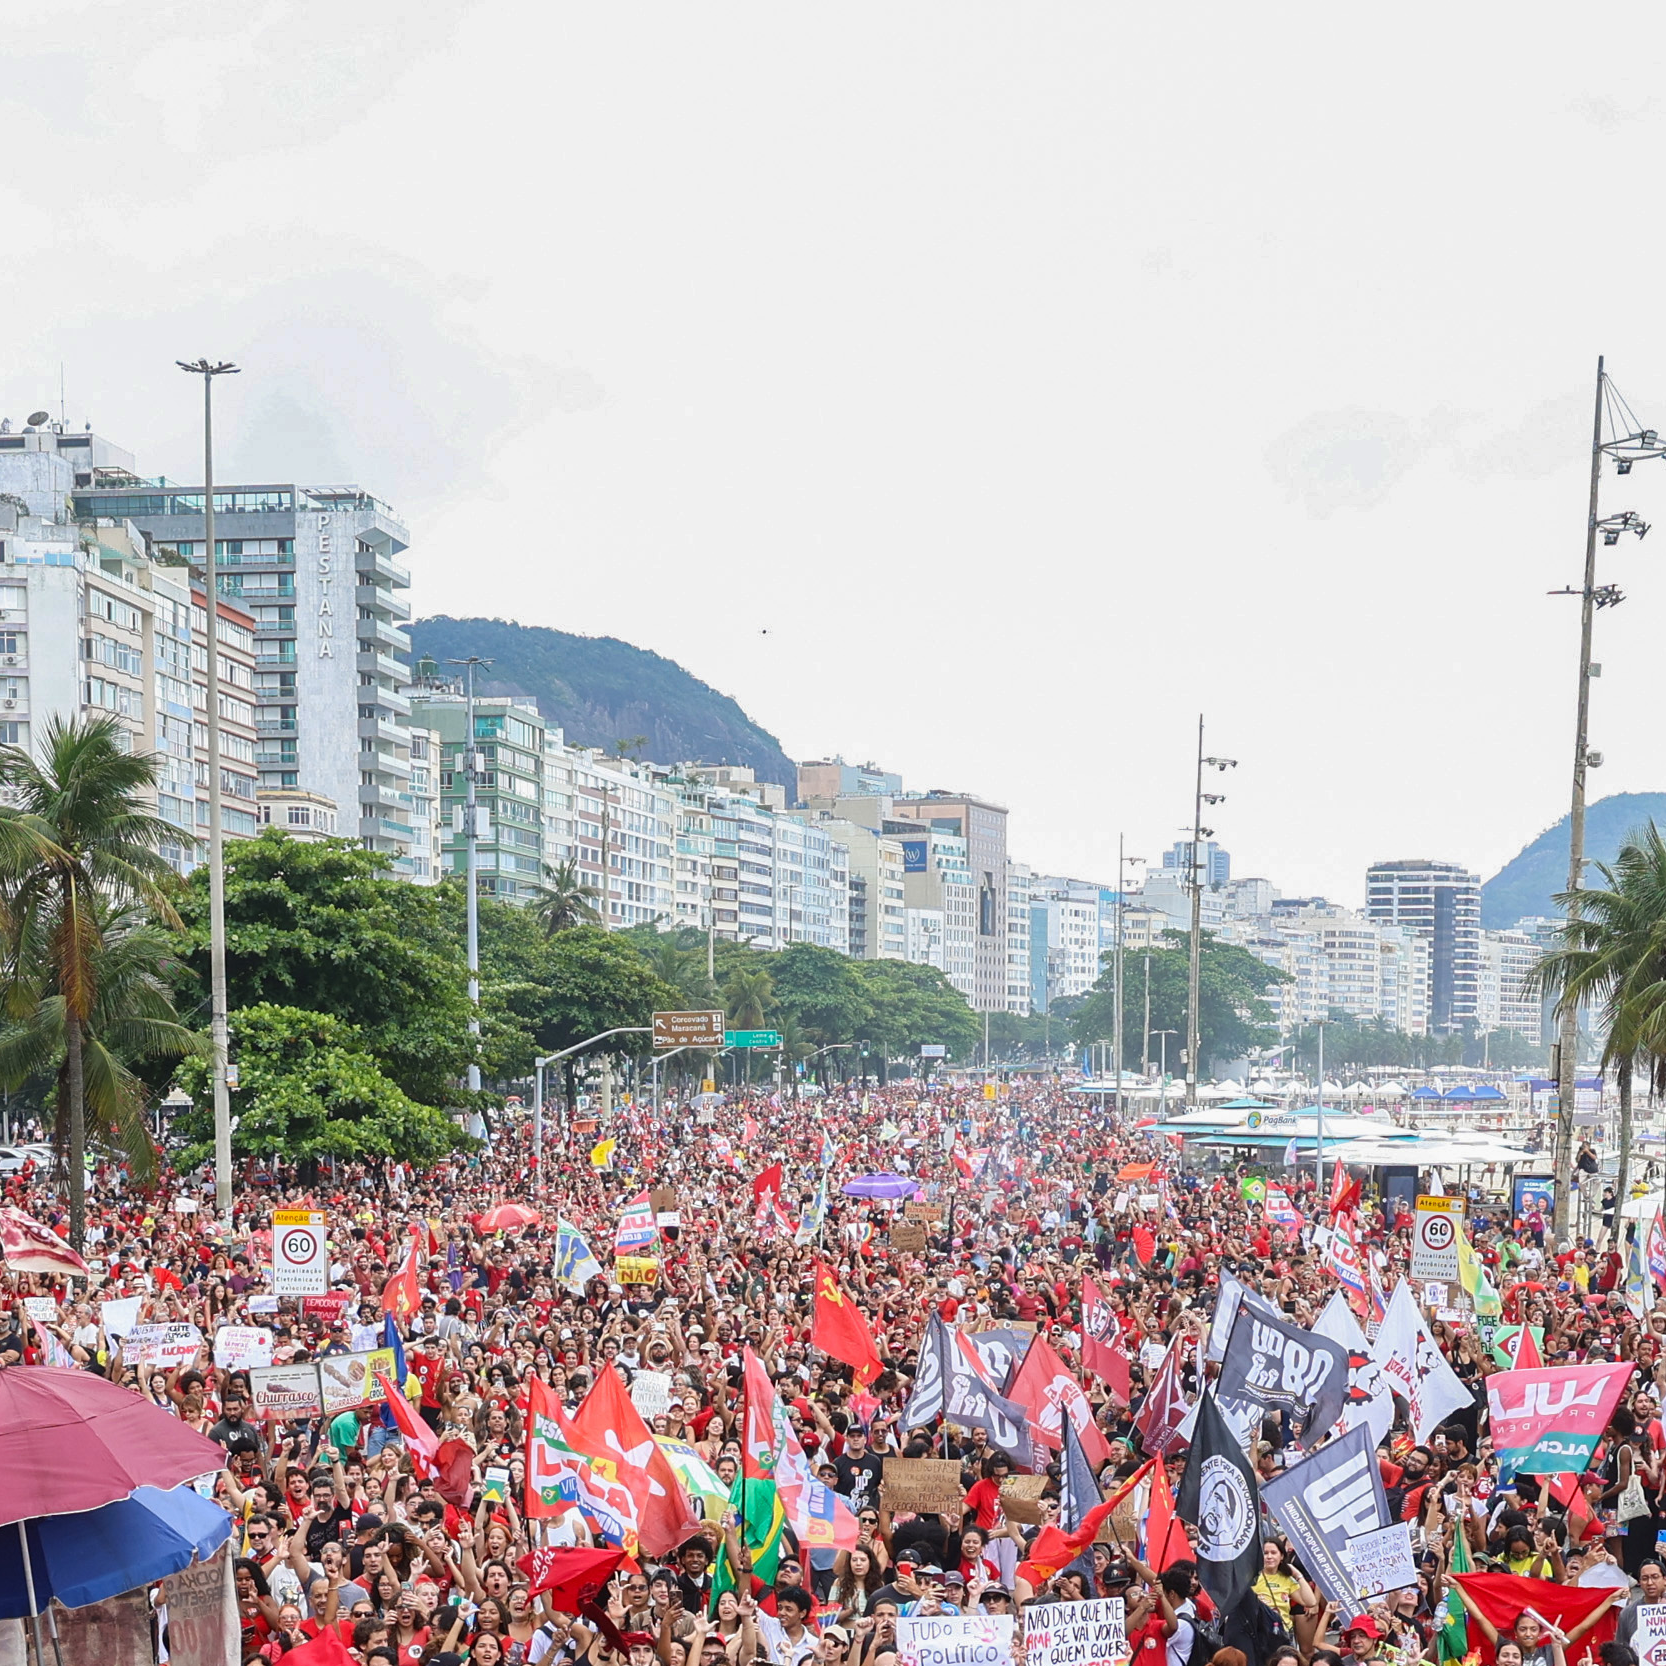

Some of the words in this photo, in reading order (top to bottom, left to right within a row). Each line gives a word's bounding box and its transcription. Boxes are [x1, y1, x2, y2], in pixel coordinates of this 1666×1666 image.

[671, 1016, 708, 1024] Corcovado
[671, 1024, 706, 1032] Maracanã
[1264, 1114, 1296, 1126] PagBank
[1419, 1199, 1450, 1208] Atenção
[275, 1212, 309, 1223] Atenção
[1430, 1222, 1448, 1236] 60
[288, 1237, 311, 1253] 60
[1416, 1251, 1456, 1260] Fiscalização
[277, 1267, 322, 1276] Fiscalização
[621, 1268, 658, 1282] NÃO
[276, 1276, 314, 1284] Eletrônica
[281, 1285, 319, 1293] Velocidade
[255, 1390, 315, 1406] Churrasco
[1027, 1605, 1050, 1632] NÃO
[1052, 1602, 1076, 1627] DIGA
[1080, 1602, 1102, 1623] QUE
[1106, 1598, 1122, 1622] ME
[909, 1620, 952, 1642] TUDO
[1026, 1631, 1051, 1649] AMA
[1053, 1628, 1067, 1647] SE
[1072, 1622, 1089, 1643] VAI
[1050, 1645, 1085, 1664] QUEM
